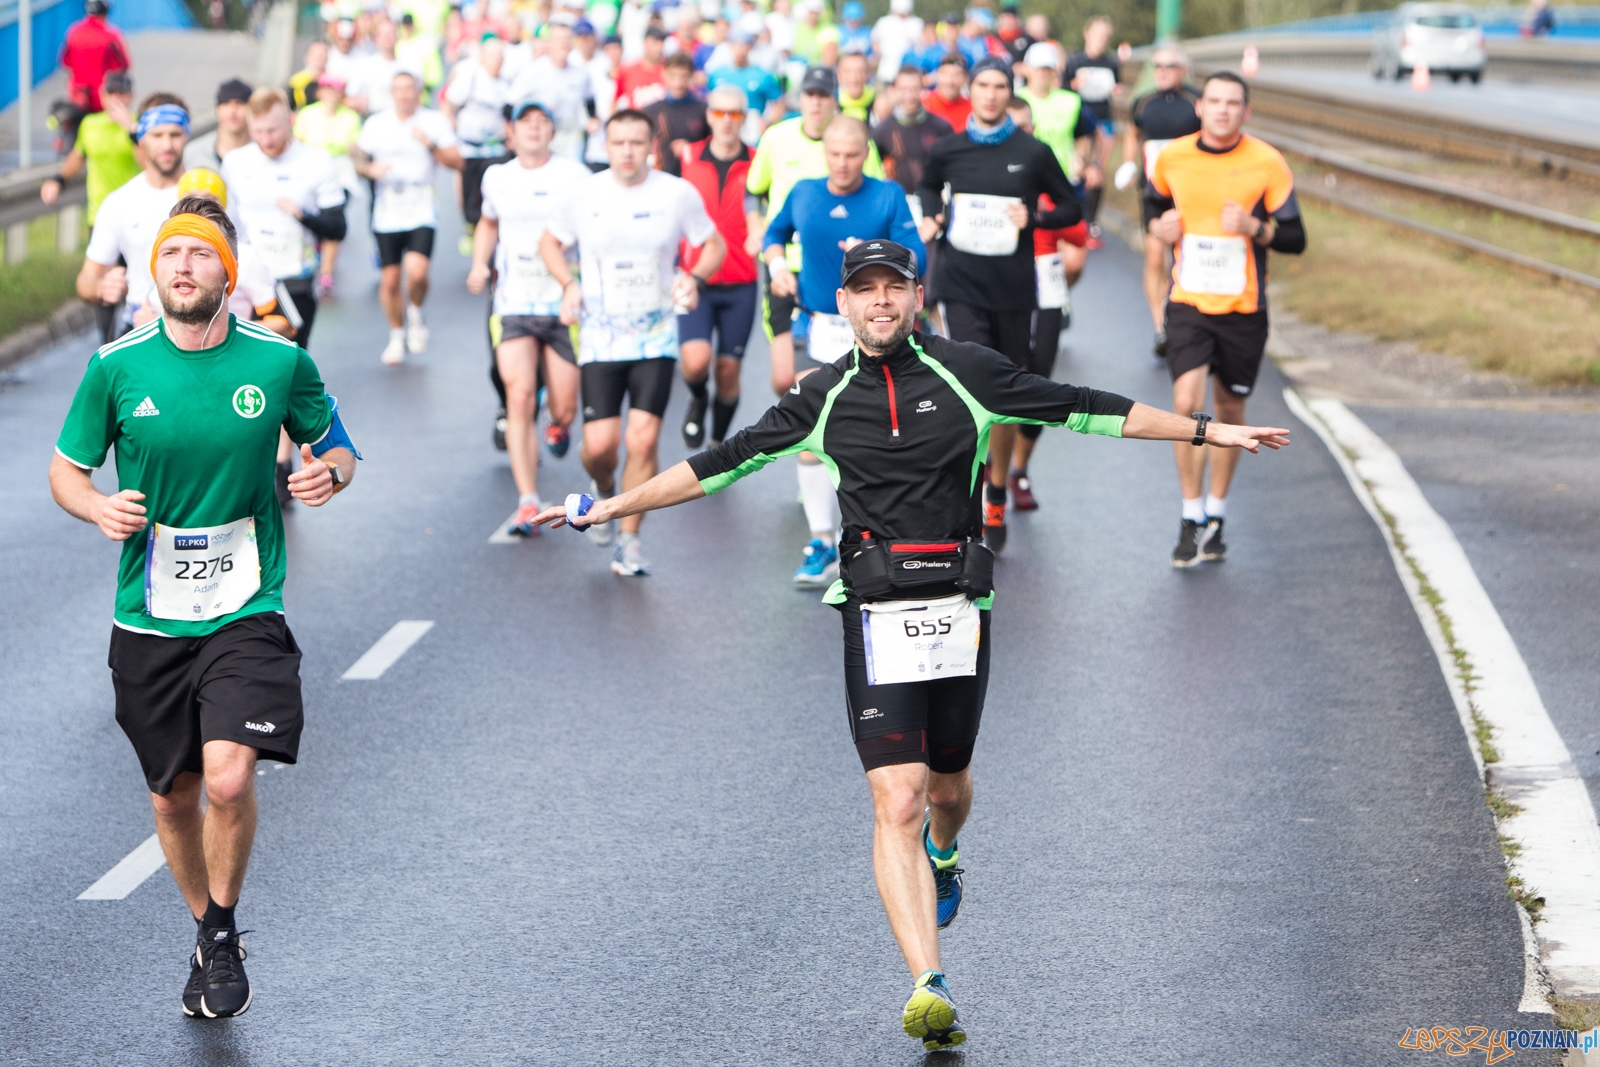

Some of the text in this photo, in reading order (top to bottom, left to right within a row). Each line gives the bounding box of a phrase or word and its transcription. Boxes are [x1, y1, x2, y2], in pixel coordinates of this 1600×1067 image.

[133, 409, 160, 417] adidas
[175, 553, 233, 579] 2276
[193, 582, 219, 593] Adam
[904, 615, 952, 637] 655
[914, 641, 944, 651] Robert
[244, 721, 269, 733] JAKO
